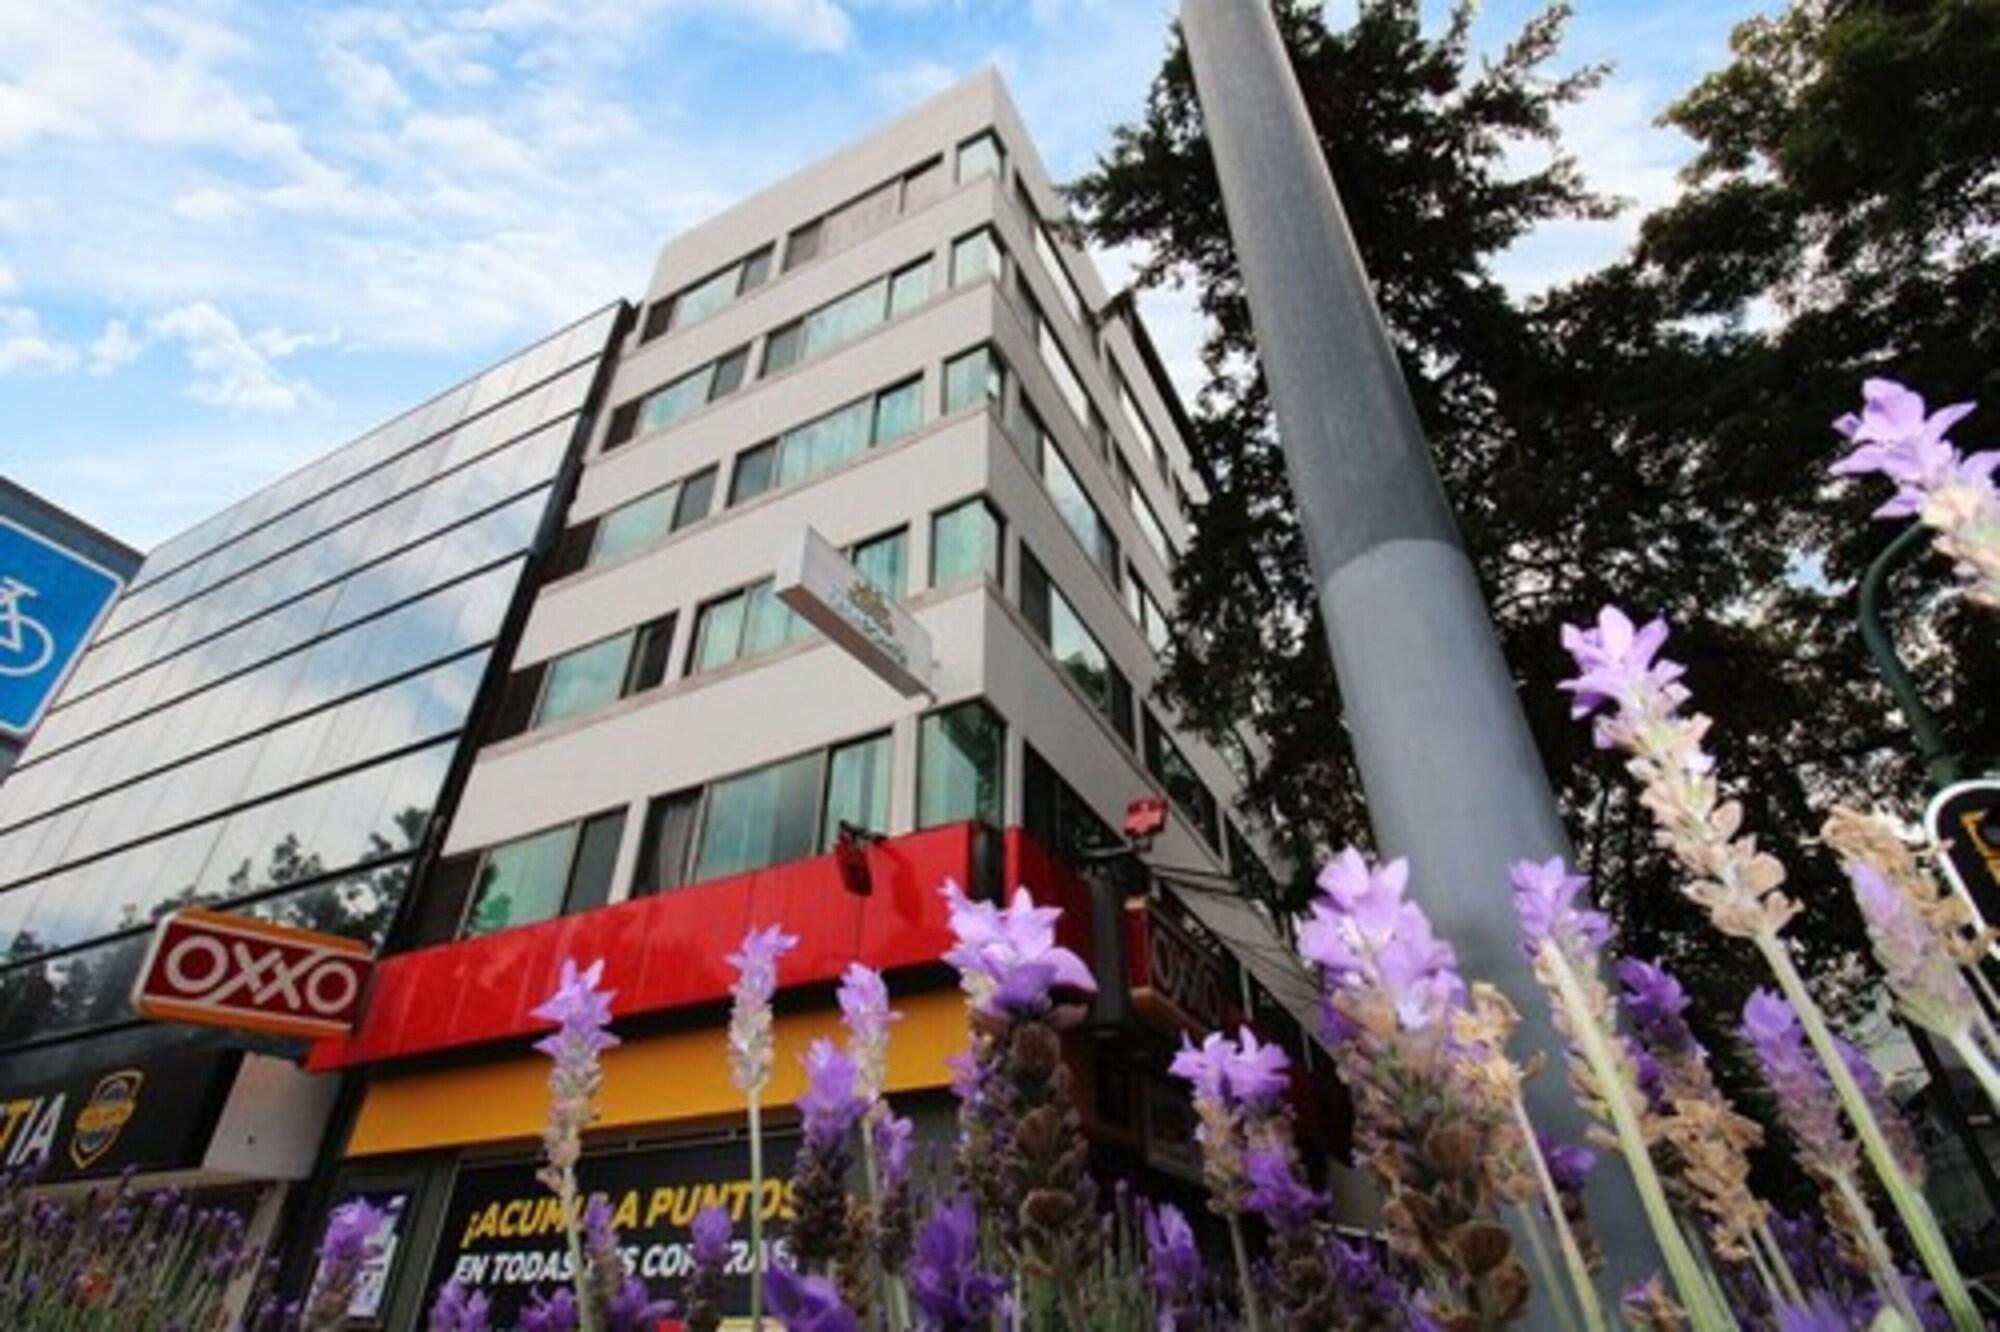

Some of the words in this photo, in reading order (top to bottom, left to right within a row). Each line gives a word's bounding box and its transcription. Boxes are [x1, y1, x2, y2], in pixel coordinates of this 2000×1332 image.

[165, 934, 358, 1014] OXXO
[1151, 925, 1222, 1028] OXXO
[456, 1253, 490, 1284] EN
[490, 1251, 577, 1284] TODAS
